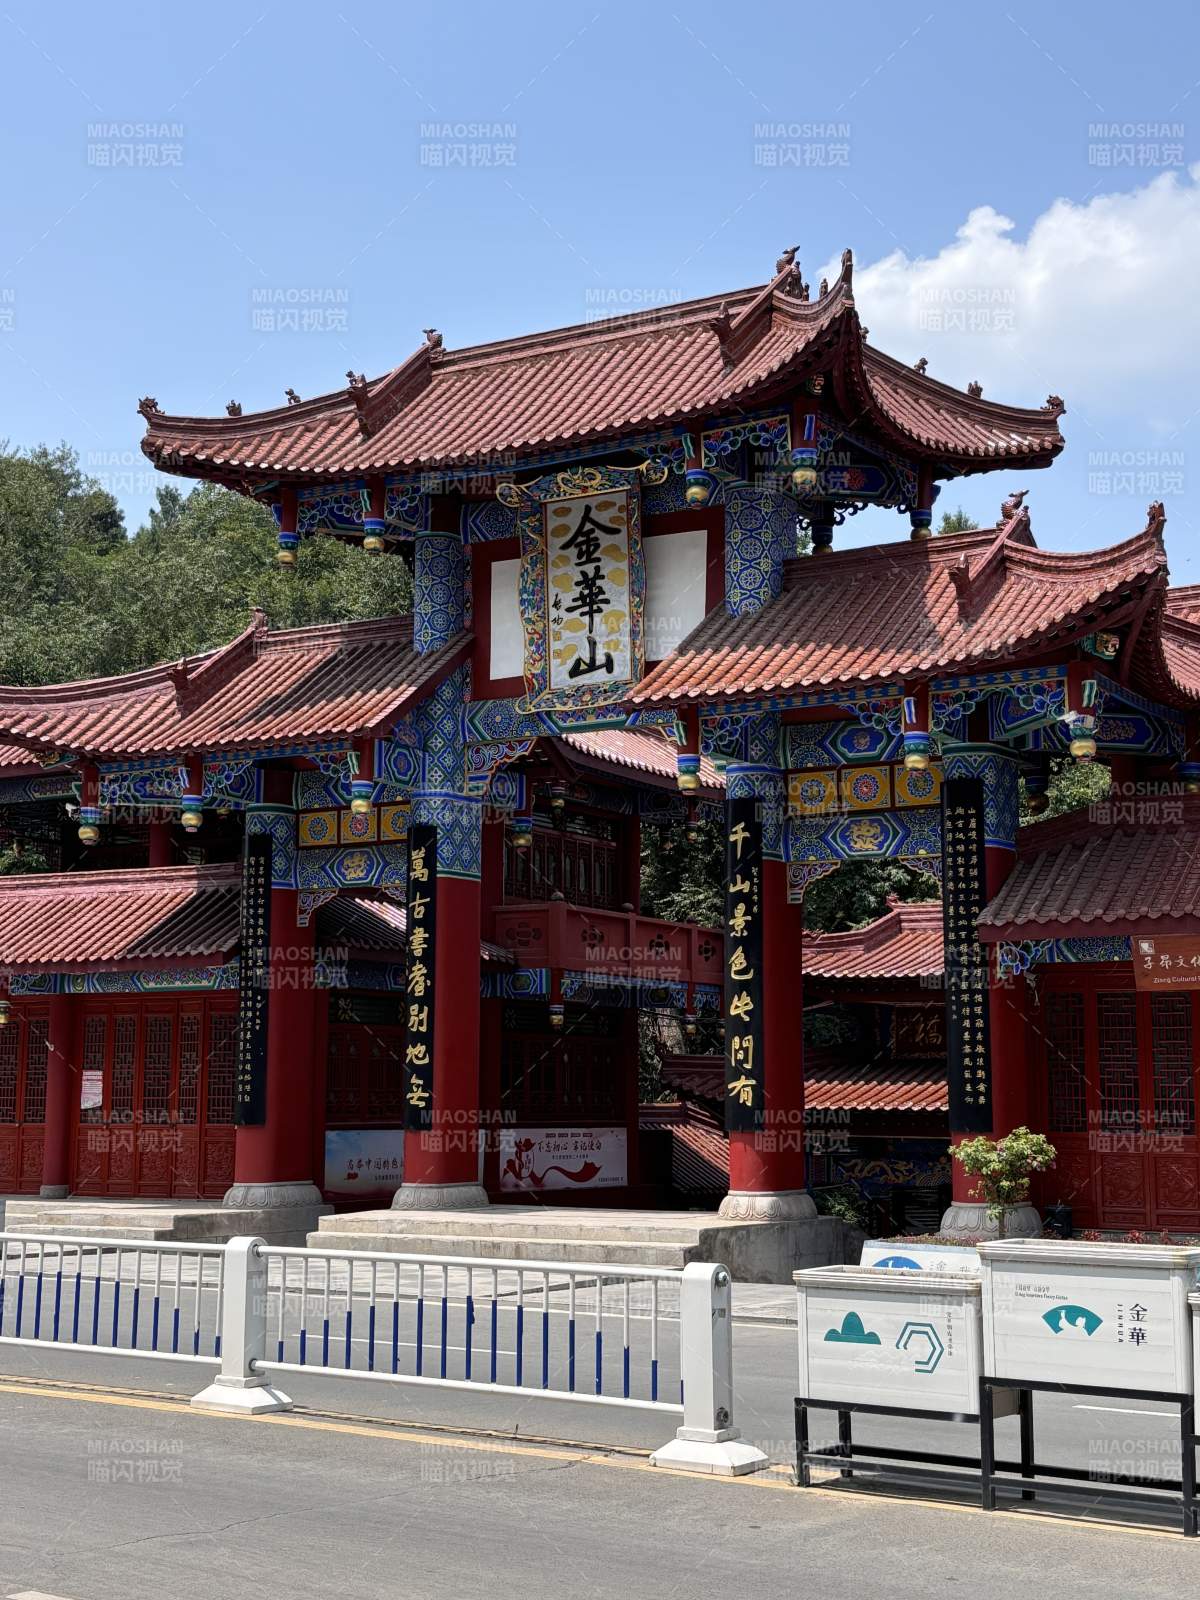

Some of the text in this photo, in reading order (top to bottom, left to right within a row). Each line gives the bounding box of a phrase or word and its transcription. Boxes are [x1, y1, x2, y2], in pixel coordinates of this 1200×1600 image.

[559, 504, 622, 680] 金華山
[345, 1156, 405, 1171] 高举中国特色
[1128, 1303, 1149, 1347] 金華
